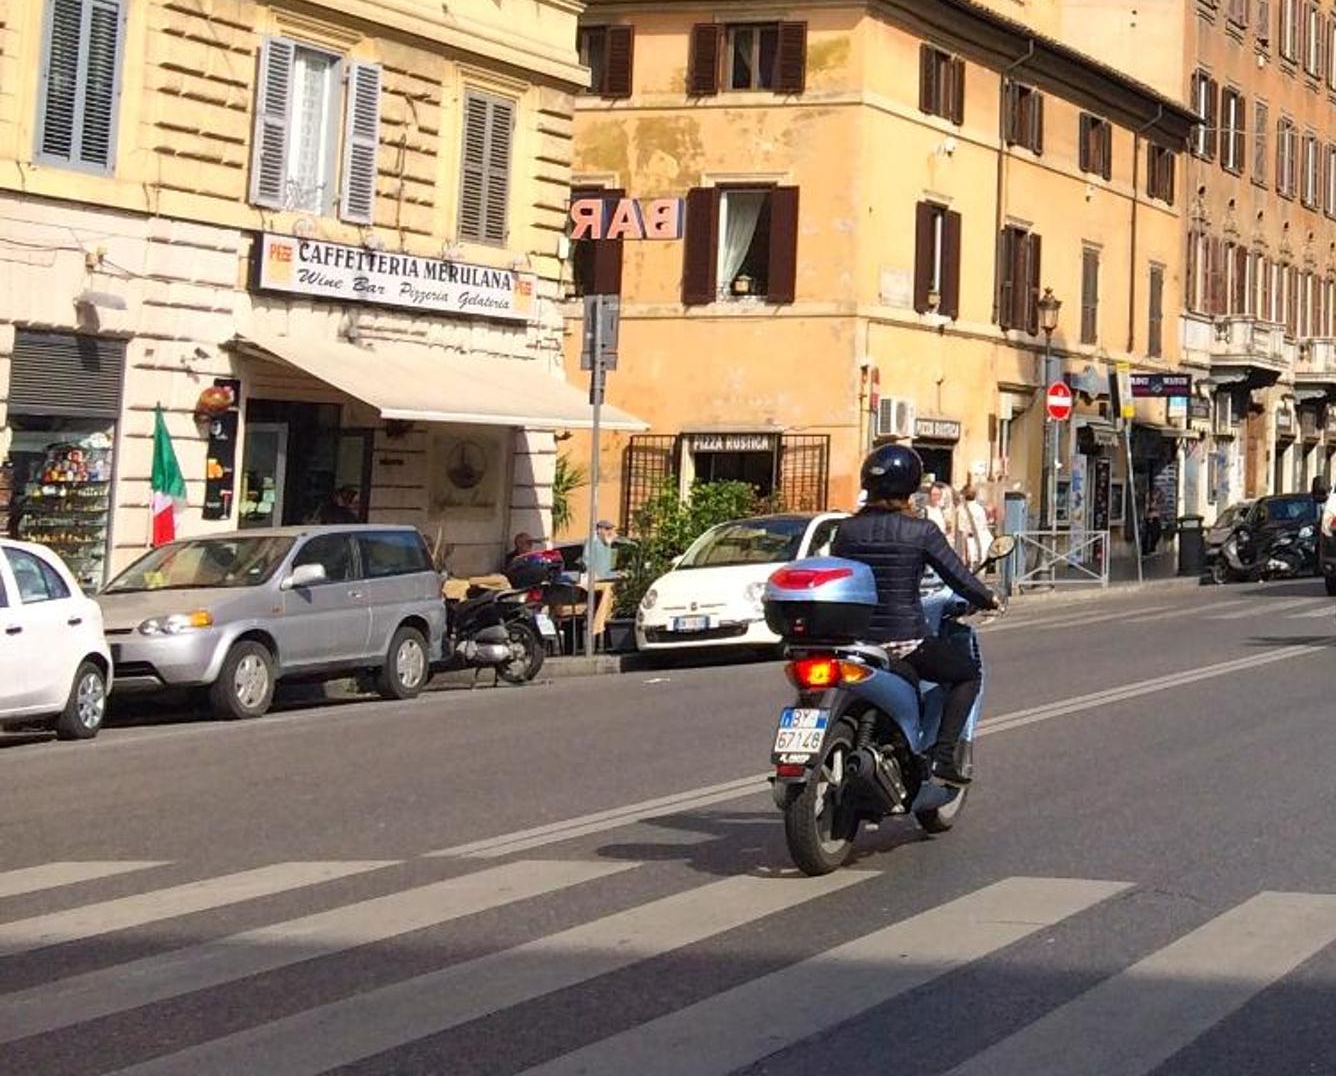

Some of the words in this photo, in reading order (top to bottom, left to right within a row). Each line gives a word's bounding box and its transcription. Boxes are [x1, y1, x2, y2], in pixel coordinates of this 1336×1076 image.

[299, 242, 419, 278] CAFFETTERIA
[423, 261, 512, 291] MERULANA
[298, 268, 343, 289] Wine
[352, 276, 385, 295] Bar
[400, 281, 449, 303] Pizzeria
[457, 291, 511, 309] Gelateria
[693, 435, 722, 450] PIZZA
[726, 435, 769, 450] RUSTICA
